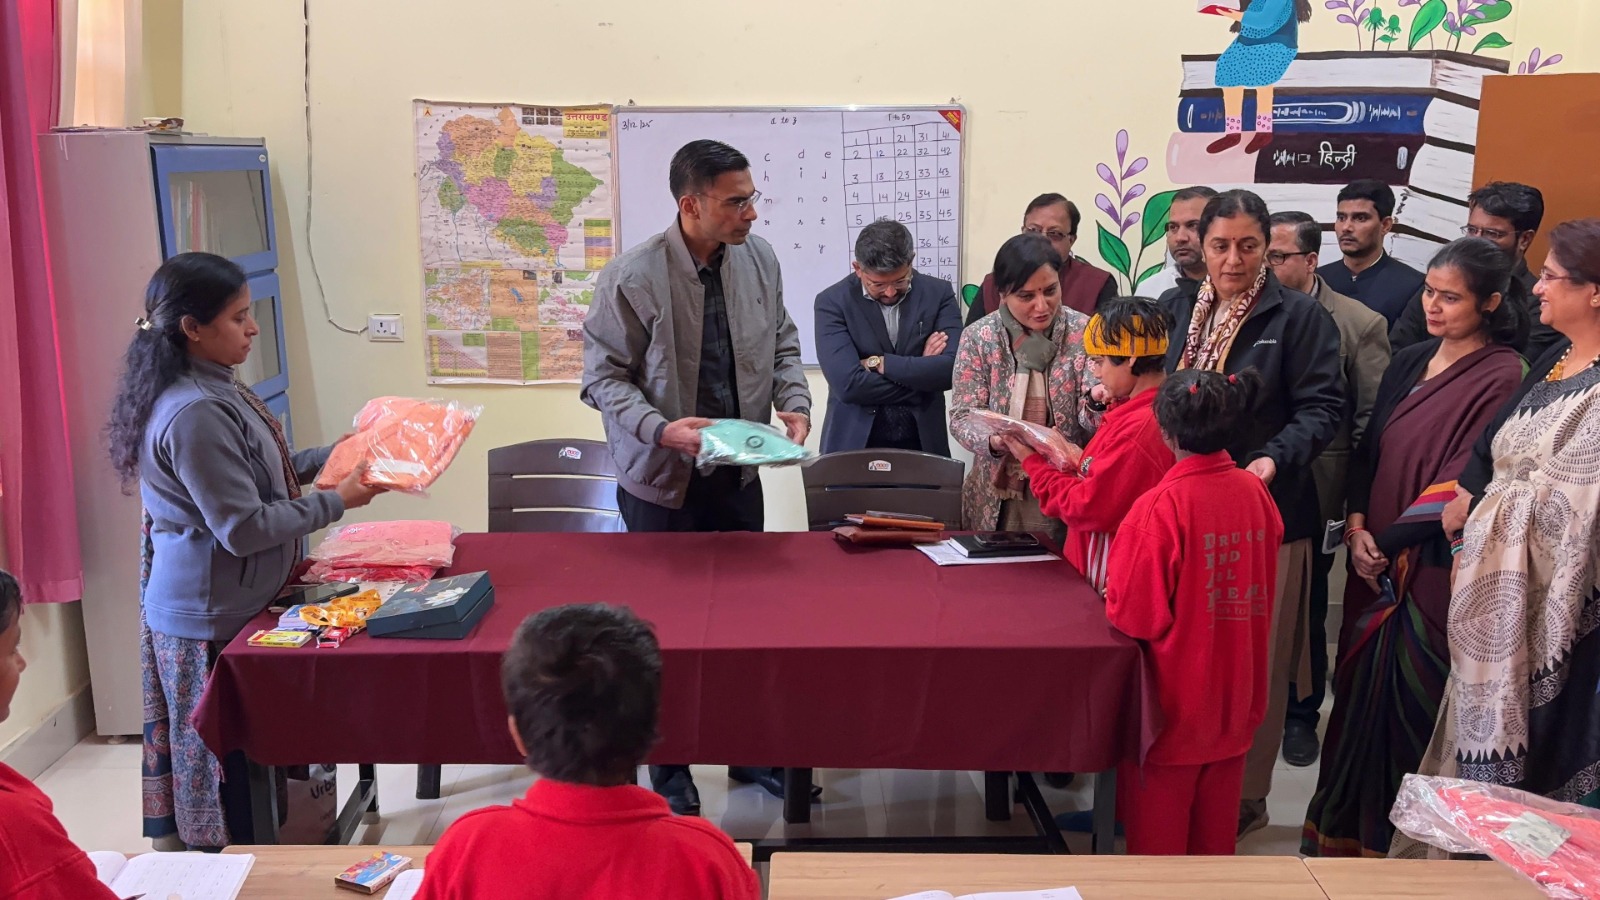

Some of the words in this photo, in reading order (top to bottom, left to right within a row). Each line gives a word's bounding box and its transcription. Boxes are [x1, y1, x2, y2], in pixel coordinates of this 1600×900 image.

[565, 113, 608, 122] उत्तराखण्ड
[770, 117, 777, 125] a
[781, 116, 789, 124] to
[892, 113, 900, 121] to
[901, 113, 911, 122] 50
[875, 136, 882, 145] 11
[896, 134, 906, 143] 21
[918, 132, 928, 142] 31
[942, 130, 950, 139] 41
[798, 148, 805, 159] d
[824, 151, 832, 159] e
[853, 150, 861, 159] 2
[876, 149, 885, 157] 12
[896, 148, 908, 156] 22
[917, 147, 929, 156] 32
[940, 146, 952, 155] 42
[1318, 141, 1358, 171] हिन्दी
[763, 169, 770, 182] h
[852, 173, 859, 184] 3
[876, 172, 884, 182] 13
[897, 170, 910, 180] 23
[918, 168, 930, 178] 33
[938, 167, 950, 176] 43
[797, 196, 804, 204] n
[822, 195, 828, 203] o
[852, 191, 859, 202] 4
[878, 192, 888, 202] 14
[897, 191, 910, 201] 24
[918, 189, 930, 199] 34
[939, 187, 949, 196] 44
[820, 216, 826, 226] t
[856, 214, 863, 226] 5
[898, 211, 912, 222] 25
[919, 210, 932, 220] 35
[938, 208, 952, 218] 45
[919, 238, 932, 248] 36
[938, 235, 949, 246] 46
[794, 242, 802, 250] x
[818, 243, 825, 255] y
[920, 257, 932, 267] 37
[940, 257, 952, 266] 47
